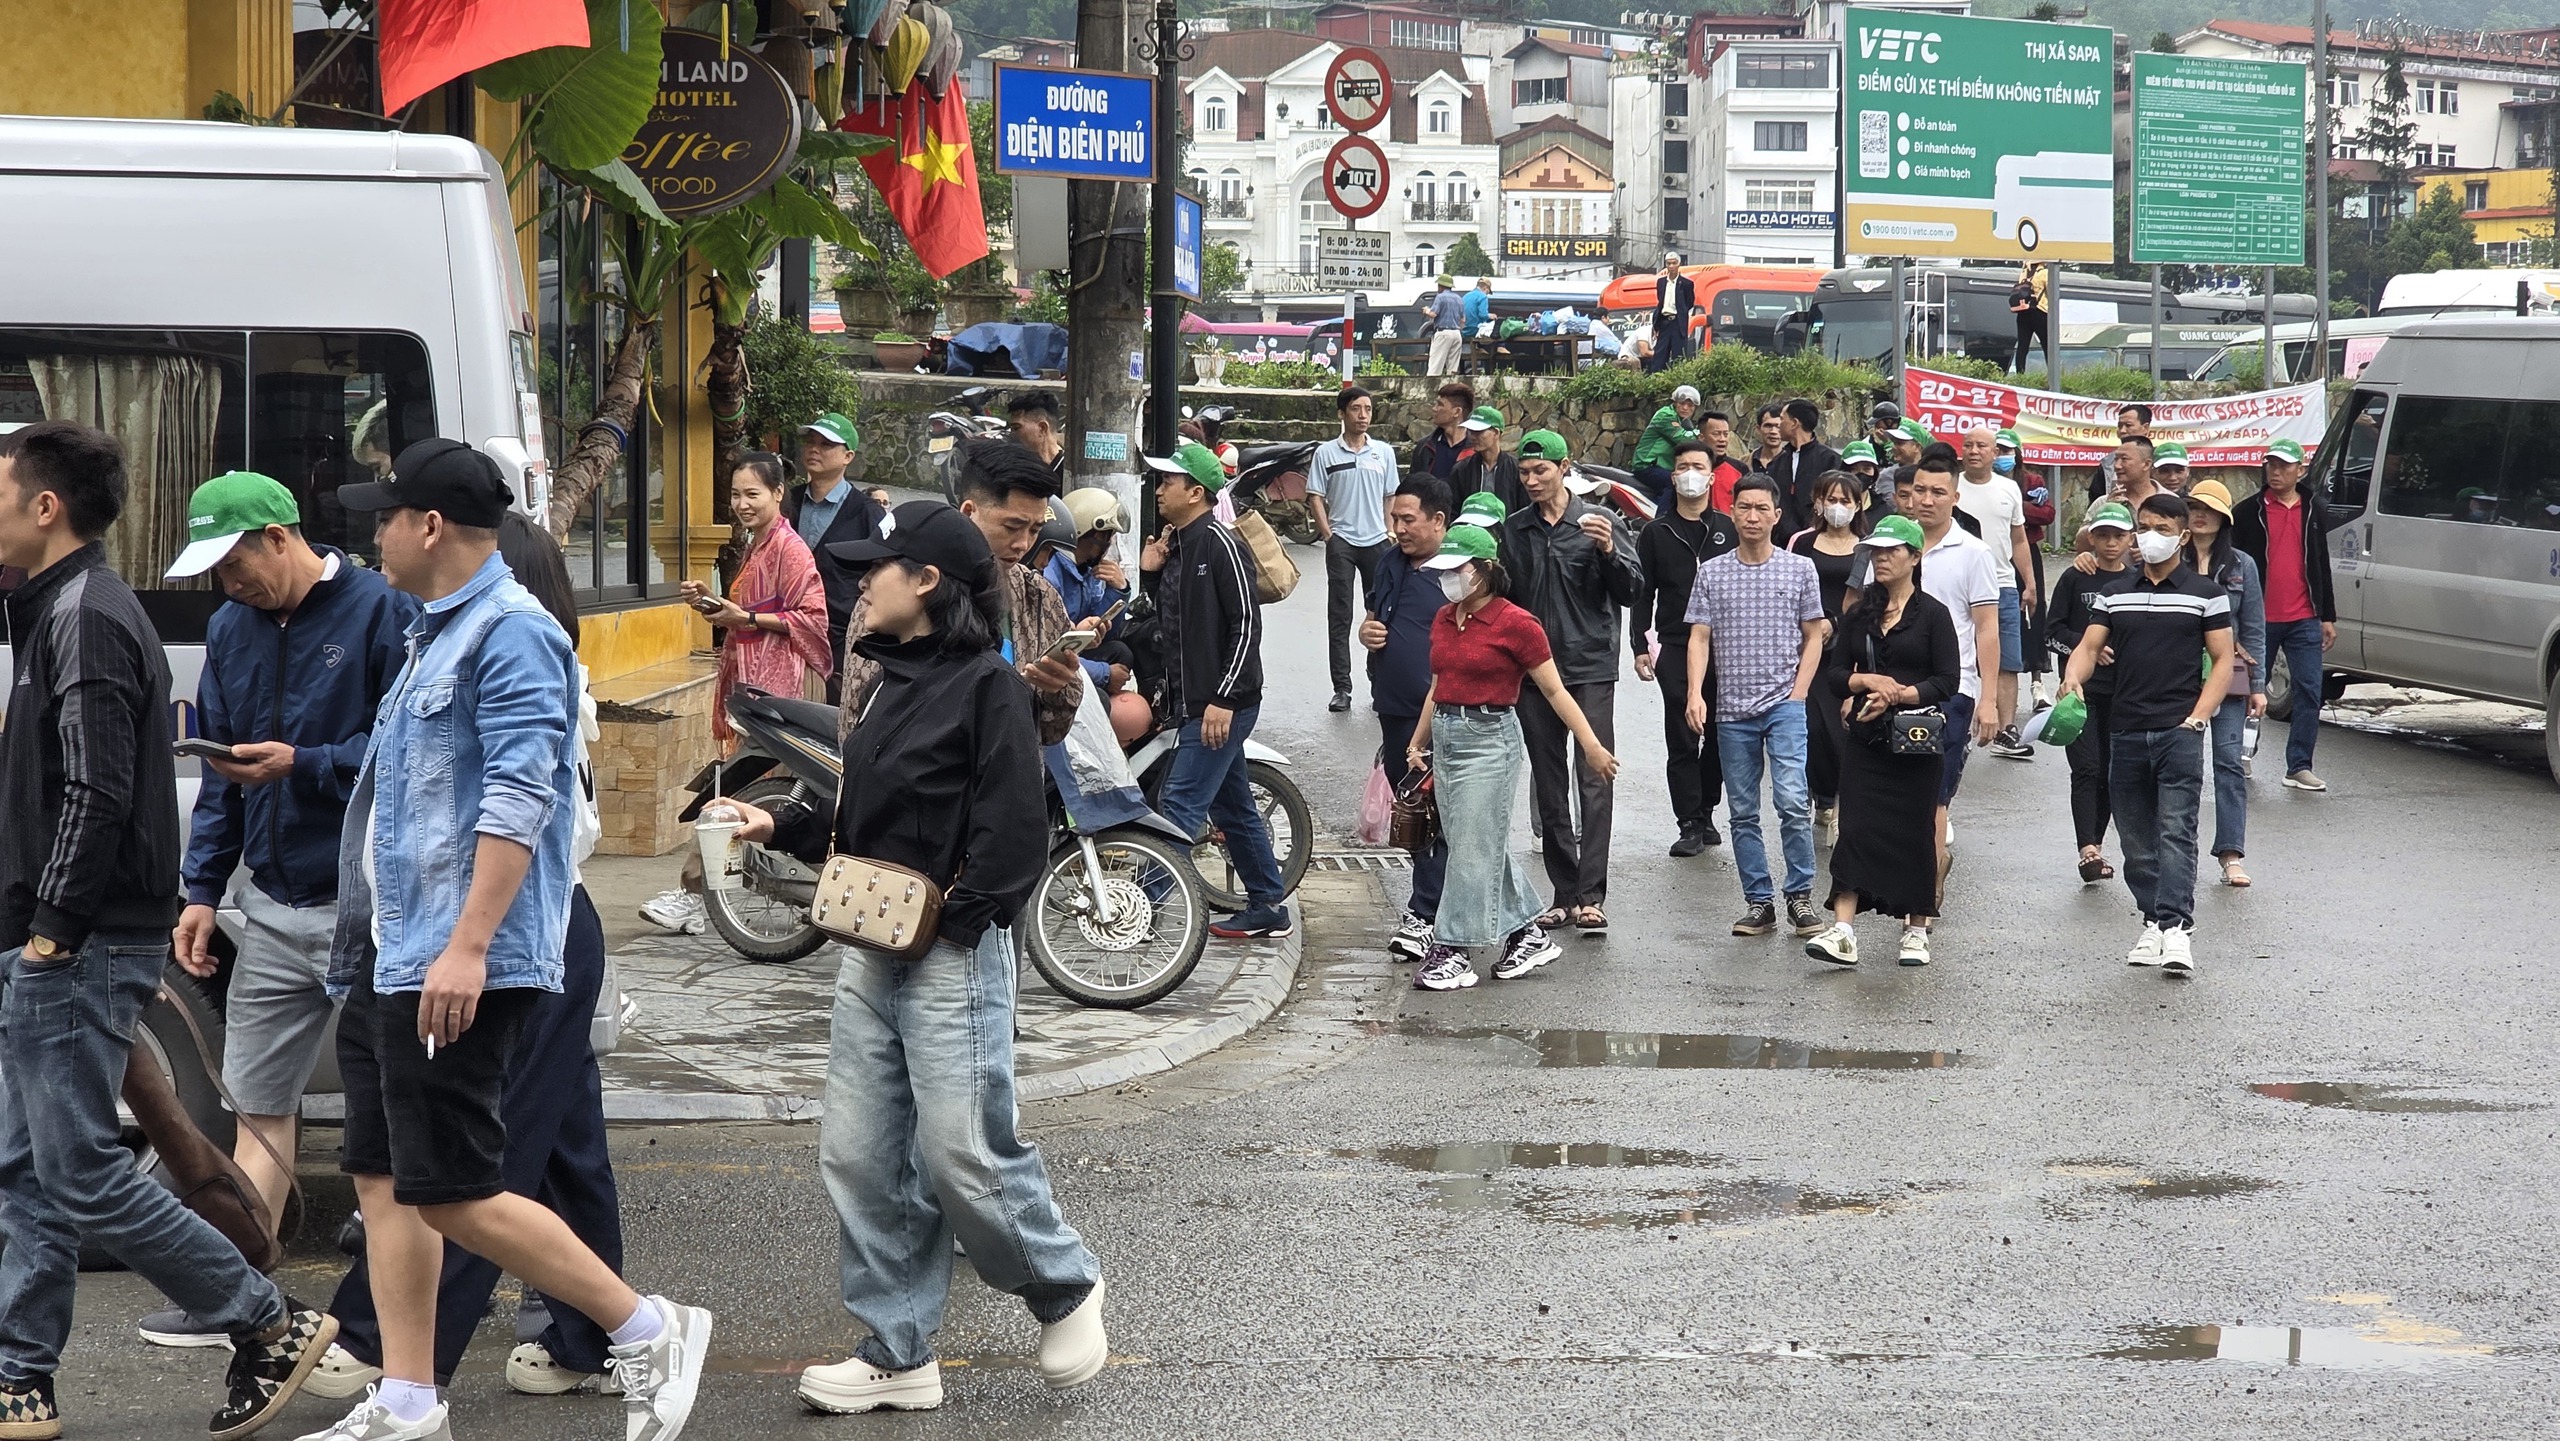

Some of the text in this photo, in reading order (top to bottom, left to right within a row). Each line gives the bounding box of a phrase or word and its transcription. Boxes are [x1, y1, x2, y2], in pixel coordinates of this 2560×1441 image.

[1859, 27, 1942, 64] VETC
[2444, 26, 2524, 58] THANH
[2025, 40, 2101, 63] THỊ XÃ SAPA
[678, 61, 749, 83] LAND
[1858, 67, 1891, 92] ĐIỂM
[1894, 73, 1916, 94] GỬI
[1919, 78, 1936, 95] XE
[1939, 77, 1960, 97] THÍ
[1962, 75, 1994, 100] ĐIỂM
[1996, 82, 2042, 103] KHÔNG
[2074, 86, 2101, 109] MẶT
[653, 91, 738, 107] HOTEL
[1047, 80, 1108, 114] ĐƯỜNG
[1926, 122, 1938, 131] an
[1938, 120, 1957, 132] toàn
[1007, 116, 1145, 164] ĐIỆN BIÊN PHỦ
[618, 132, 751, 169] offee
[1914, 142, 1976, 158] Đi nhanh chóng
[1347, 170, 1374, 187] 10T
[1914, 165, 1971, 181] Giá minh bạch
[652, 177, 717, 195] FOOD
[1729, 212, 1834, 225] HOA ĐÀO HOTEL
[1872, 225, 1955, 237] 1900 6010 vetc.com.vn
[1327, 236, 1335, 246] 6:
[1338, 237, 1348, 247] 00
[1356, 238, 1368, 248] 23:
[1371, 239, 1382, 248] 00
[1507, 240, 1607, 257] GALAXY SPA
[1324, 265, 1336, 276] 00:
[1339, 266, 1350, 276] 00
[1357, 267, 1370, 277] 24:
[1372, 267, 1383, 277] 00
[2179, 331, 2239, 342] QUANG GIANG
[2352, 352, 2373, 364] 1900
[1919, 380, 2005, 407] 20-27
[2025, 395, 2057, 420] HỘI
[2062, 398, 2102, 424] CHỢ
[2179, 404, 2212, 425] MẠI
[2215, 400, 2261, 421] SAPA
[2266, 396, 2304, 417] 2025
[2189, 431, 2212, 443] THỊ
[2214, 428, 2231, 440] XÃ
[2233, 428, 2269, 439] SAPA
[2041, 448, 2063, 460] ĐÊM
[2064, 448, 2077, 460] CÓ
[2187, 450, 2205, 462] CỦA
[2207, 450, 2225, 462] CÁC
[2227, 451, 2249, 462] NGHỆ
